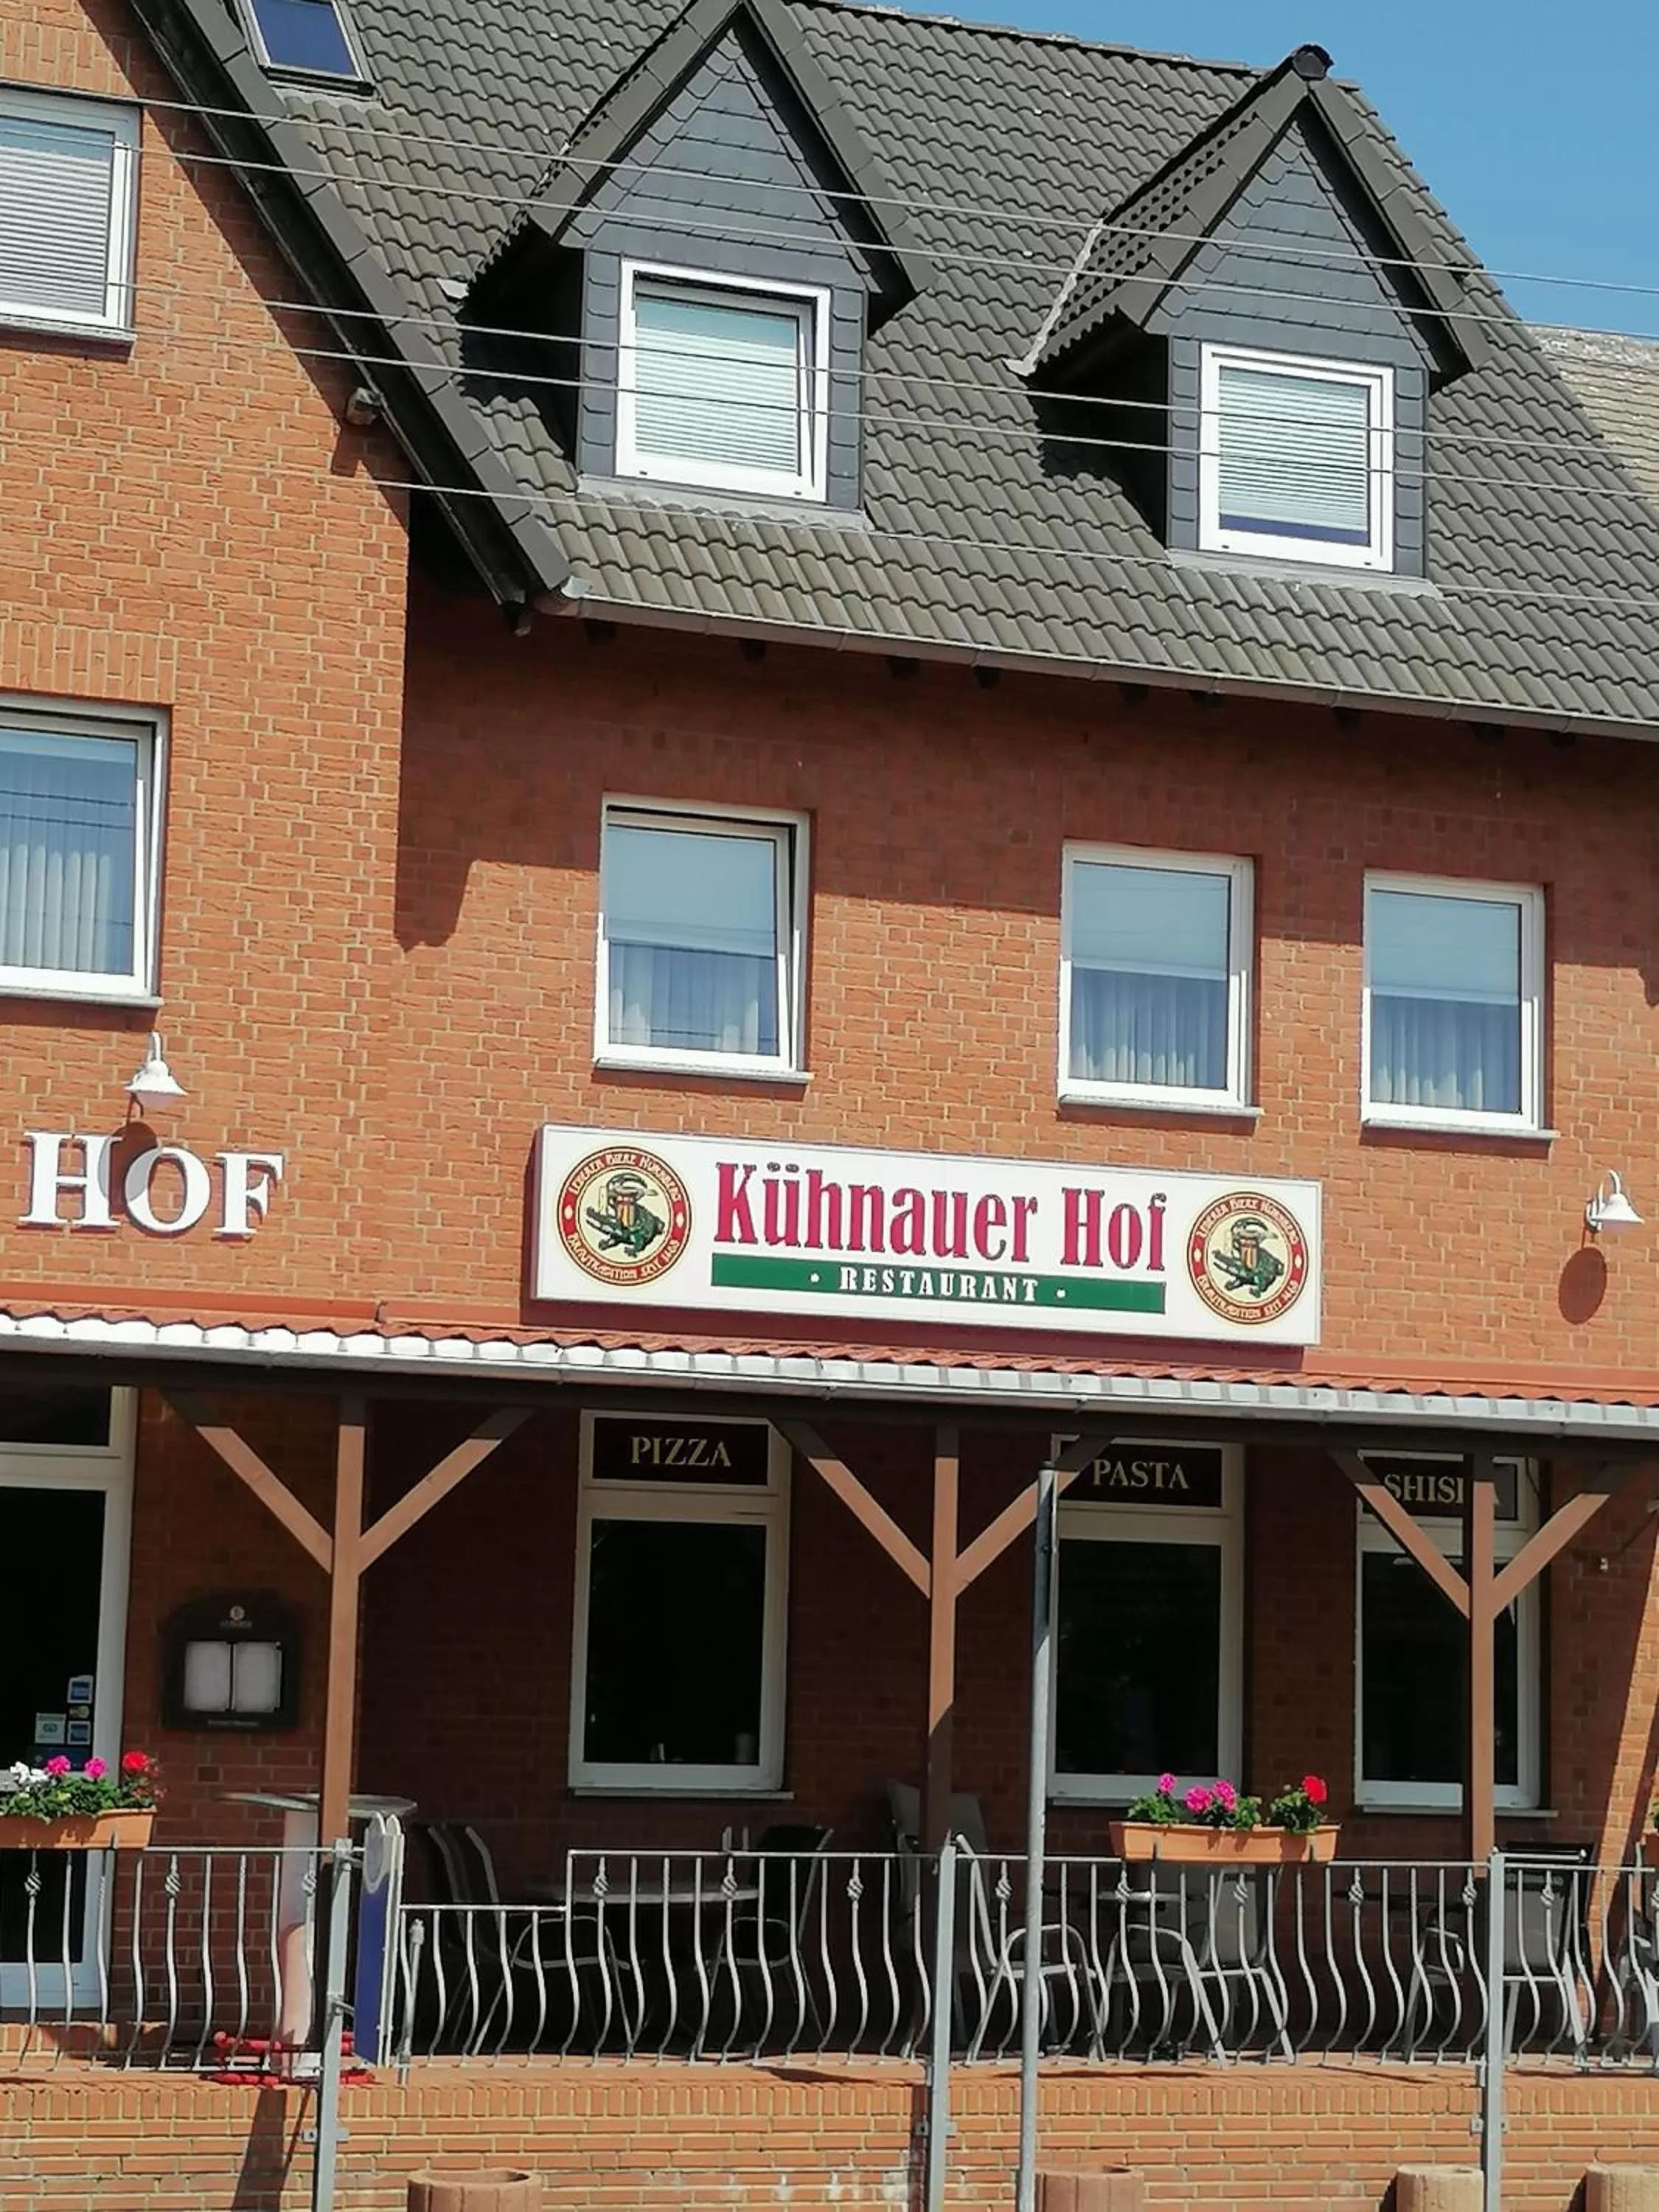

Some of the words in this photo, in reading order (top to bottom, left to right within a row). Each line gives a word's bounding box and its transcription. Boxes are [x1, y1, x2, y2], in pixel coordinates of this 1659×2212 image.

[19, 1132, 284, 1234] HOF
[713, 1162, 1038, 1263] Kühnauer
[1060, 1188, 1167, 1271] Hof
[840, 1267, 1039, 1302] RESTAURANT
[631, 1437, 731, 1467] PIZZA
[1093, 1459, 1189, 1489] PASTA
[1384, 1474, 1499, 1504] SHIS
